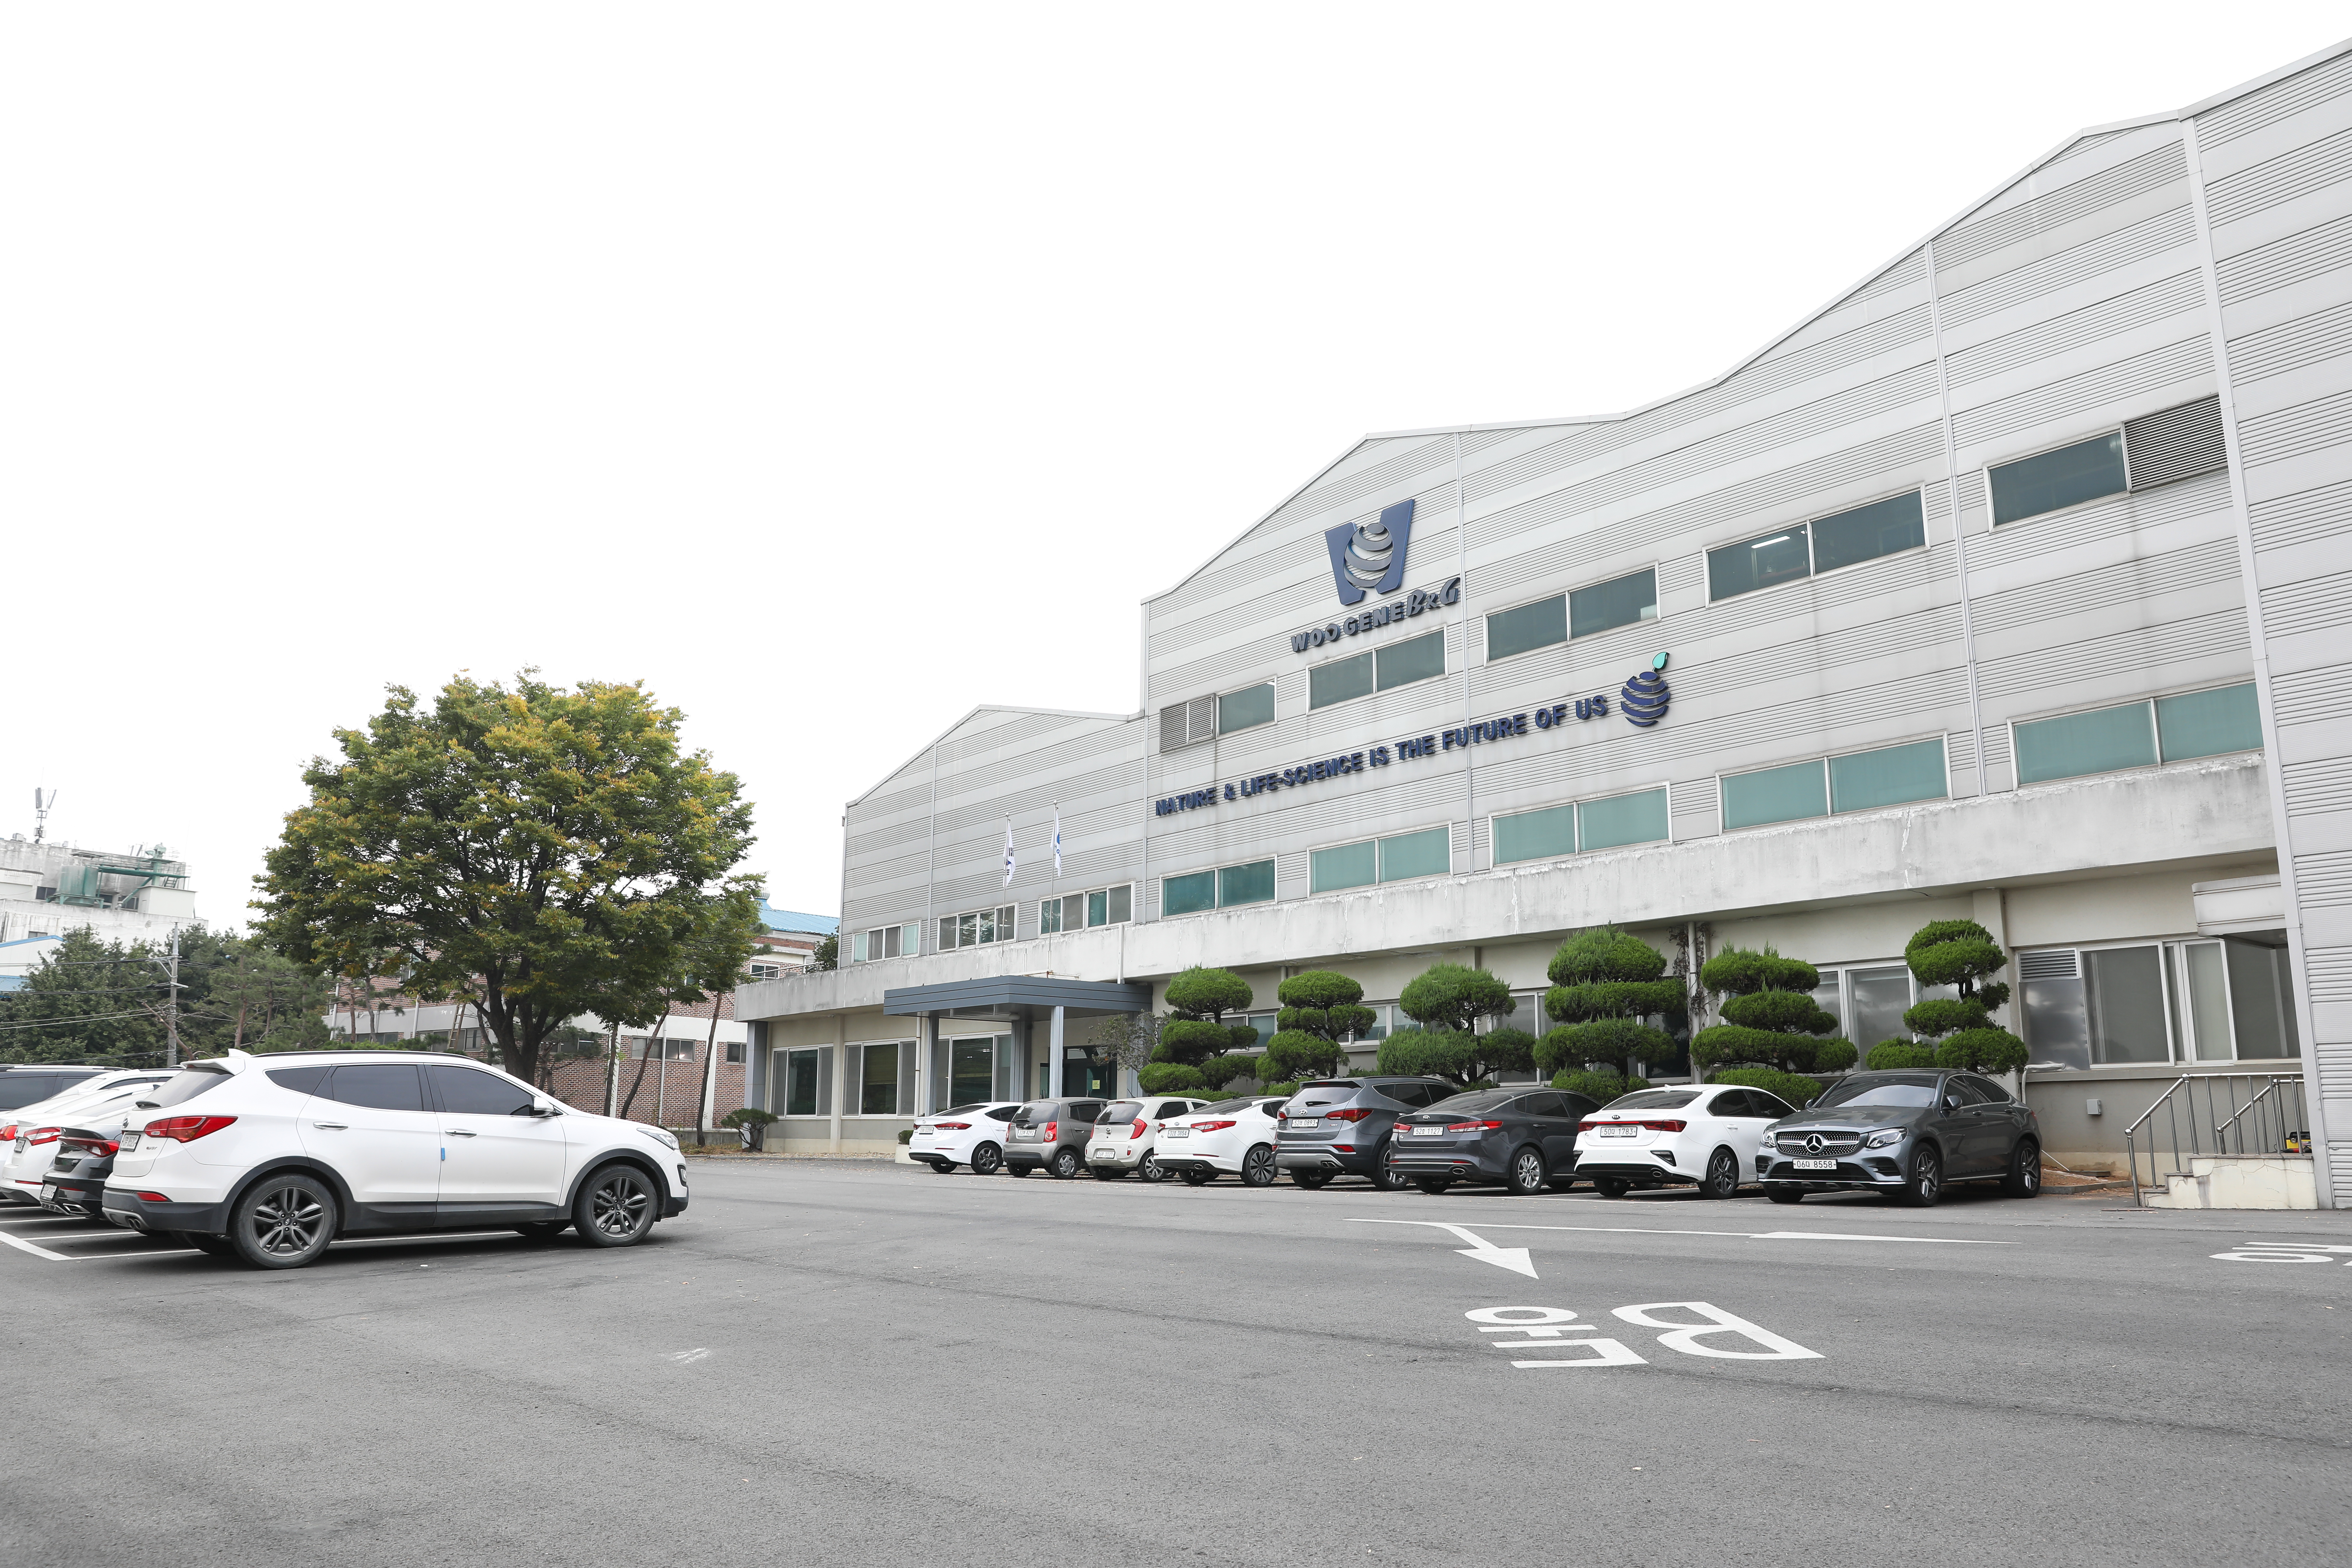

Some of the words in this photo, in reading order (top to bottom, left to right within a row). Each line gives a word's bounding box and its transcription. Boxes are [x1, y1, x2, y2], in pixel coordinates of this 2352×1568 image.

[1155, 787, 1217, 816] NATURE
[1224, 783, 1236, 800] &
[1241, 752, 1363, 797] LIFE-SCIENCE
[1370, 746, 1389, 767] IS
[1394, 735, 1435, 760] THE
[1442, 713, 1528, 750] FUTURE
[1535, 704, 1567, 729] OF
[1575, 695, 1609, 720] US
